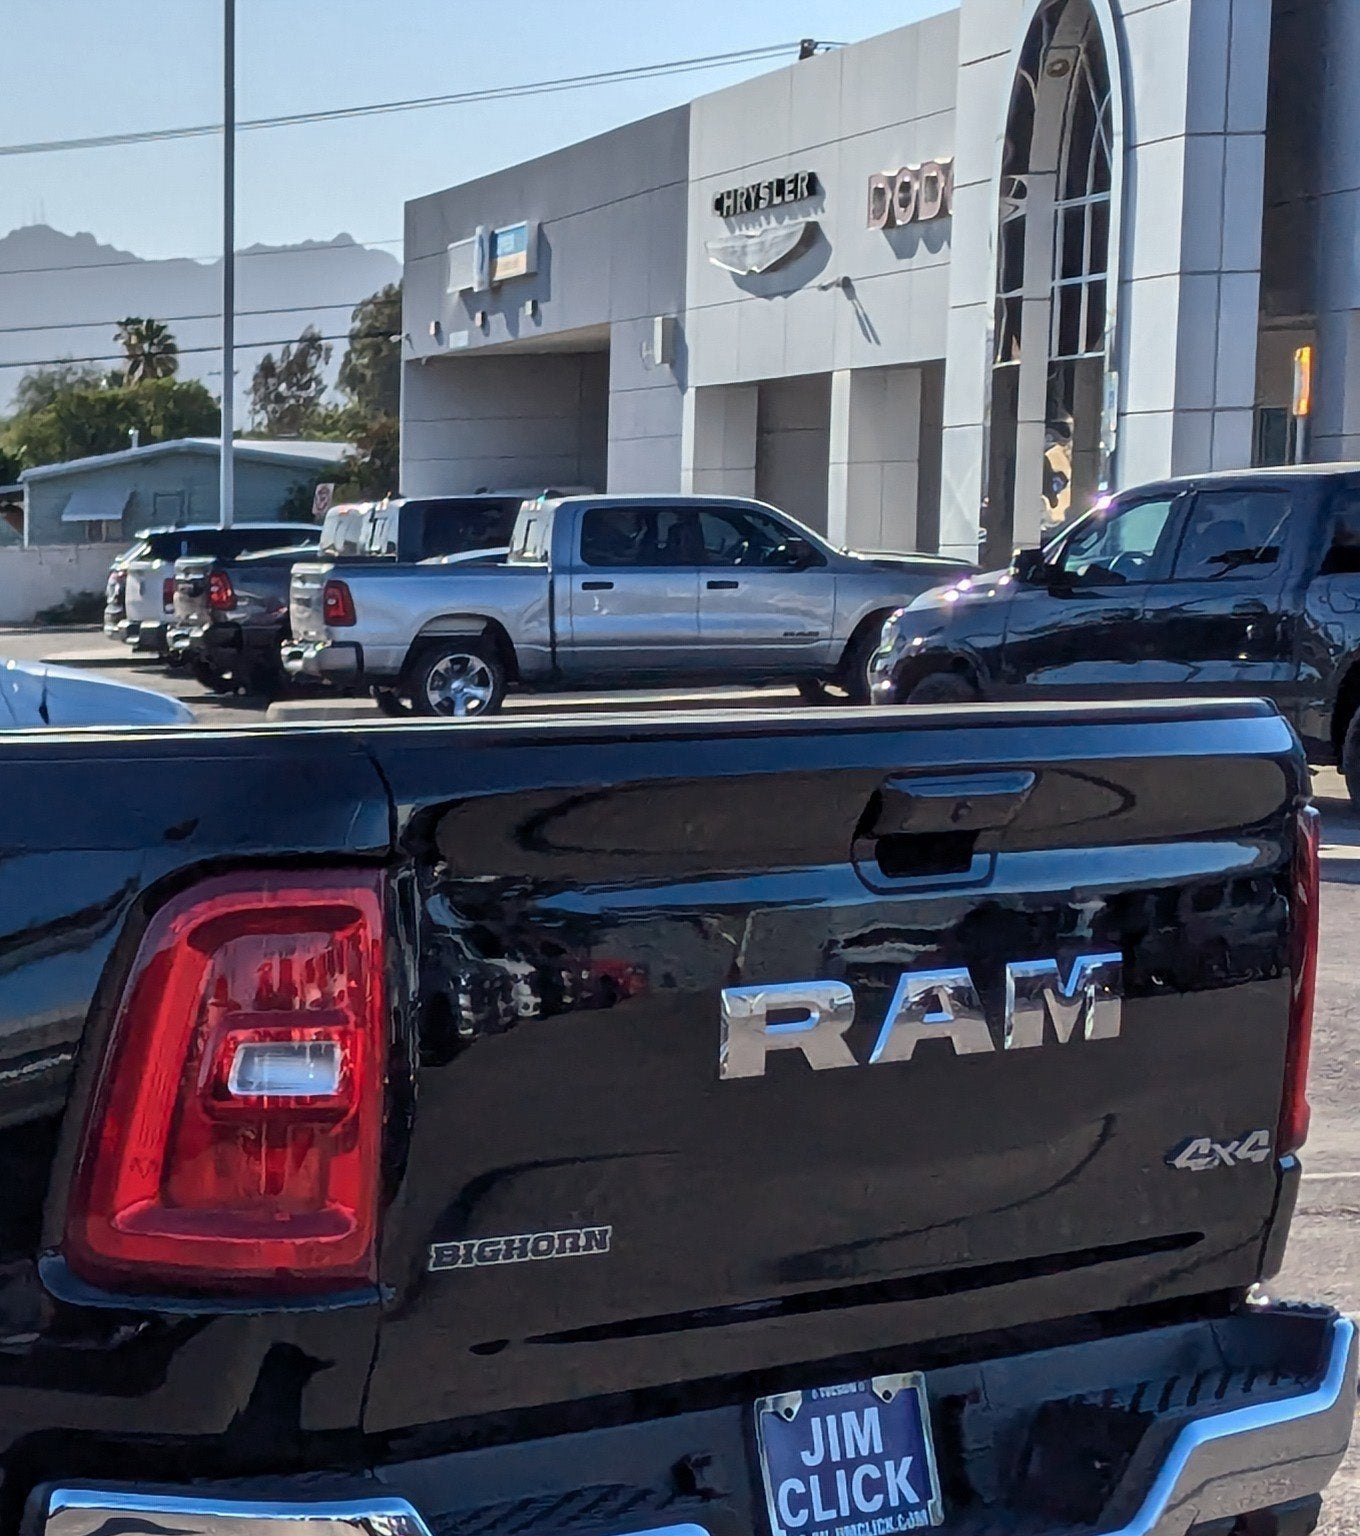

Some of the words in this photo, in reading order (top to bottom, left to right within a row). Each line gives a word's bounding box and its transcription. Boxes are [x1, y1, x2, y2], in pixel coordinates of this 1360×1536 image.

[711, 170, 819, 219] CHRYSLER
[867, 156, 954, 231] DOD
[720, 951, 1123, 1080] RAM
[800, 1406, 883, 1466] JIM
[777, 1456, 920, 1527] CLICK
